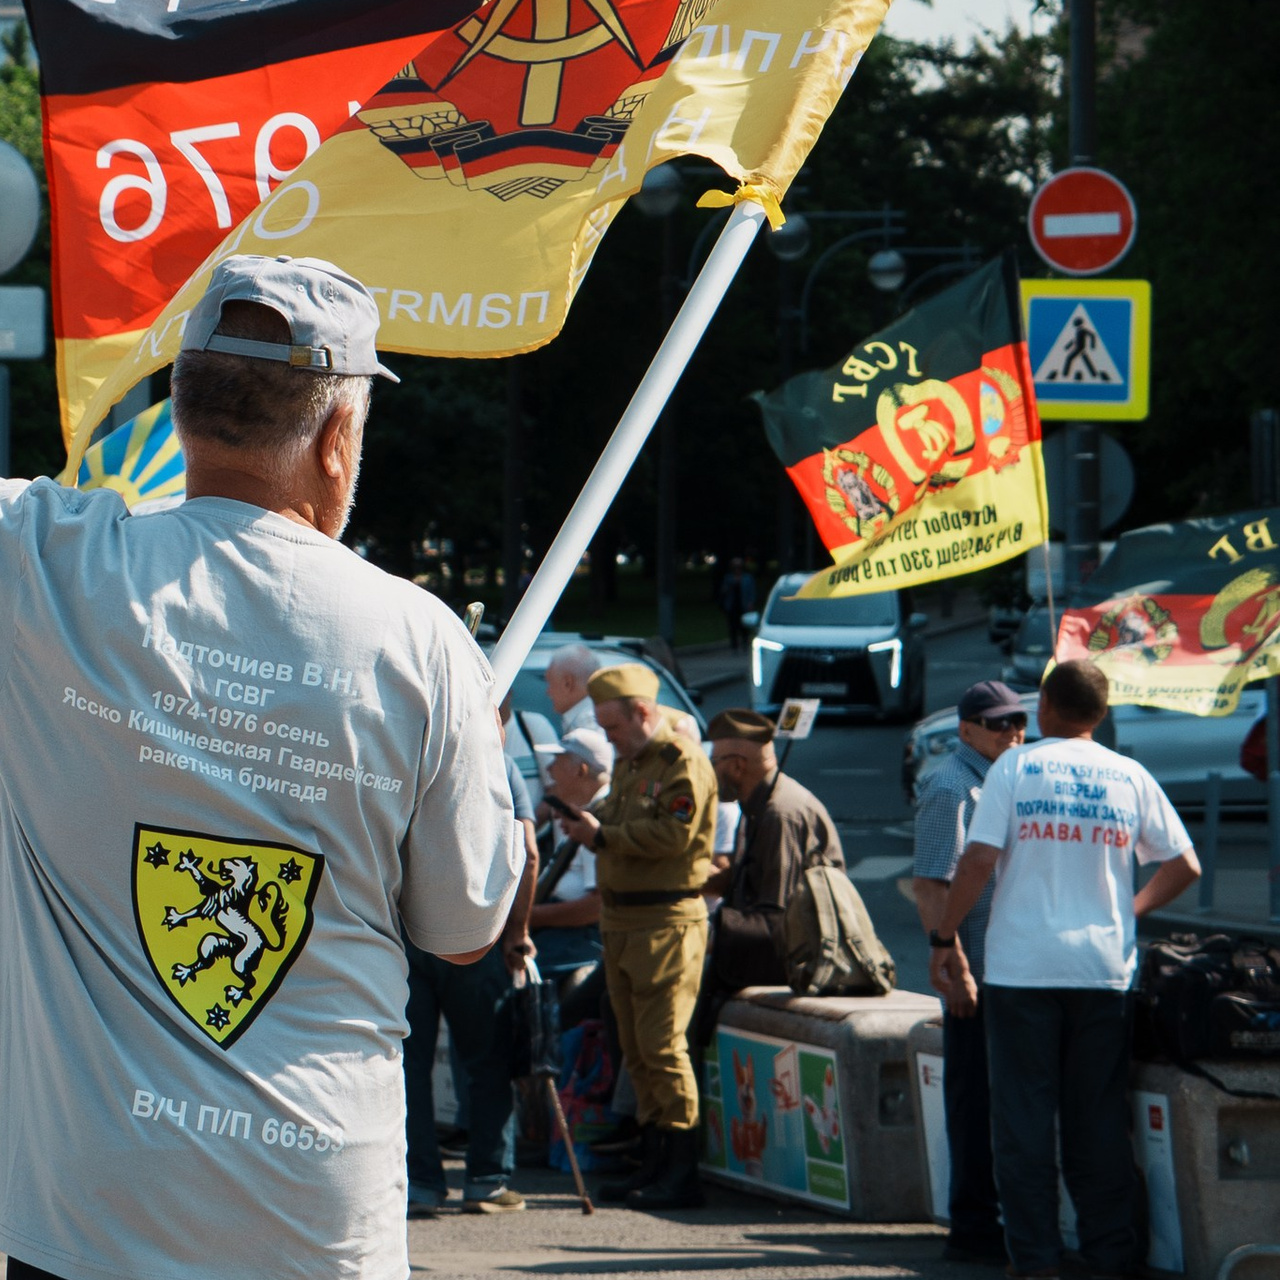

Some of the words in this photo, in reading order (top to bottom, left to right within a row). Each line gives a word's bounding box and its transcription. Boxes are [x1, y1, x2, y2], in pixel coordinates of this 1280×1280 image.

[141, 627, 294, 684] Надточиев
[214, 678, 275, 708] ГСВГ
[62, 686, 122, 725] Ясско
[127, 708, 272, 764] Кишиневская
[277, 745, 404, 795] Гвардейская
[151, 691, 258, 734] 1974-1976
[262, 718, 331, 748] осень
[138, 742, 234, 784] ракетная
[238, 766, 328, 804] бригада
[1054, 780, 1107, 799] ВПЕРЕДИ
[1016, 800, 1098, 819] ПОГРАНИЧНЫХ
[1018, 821, 1083, 842] СЛАВА
[132, 1089, 187, 1128] В/Ч
[197, 1104, 253, 1140] П/П
